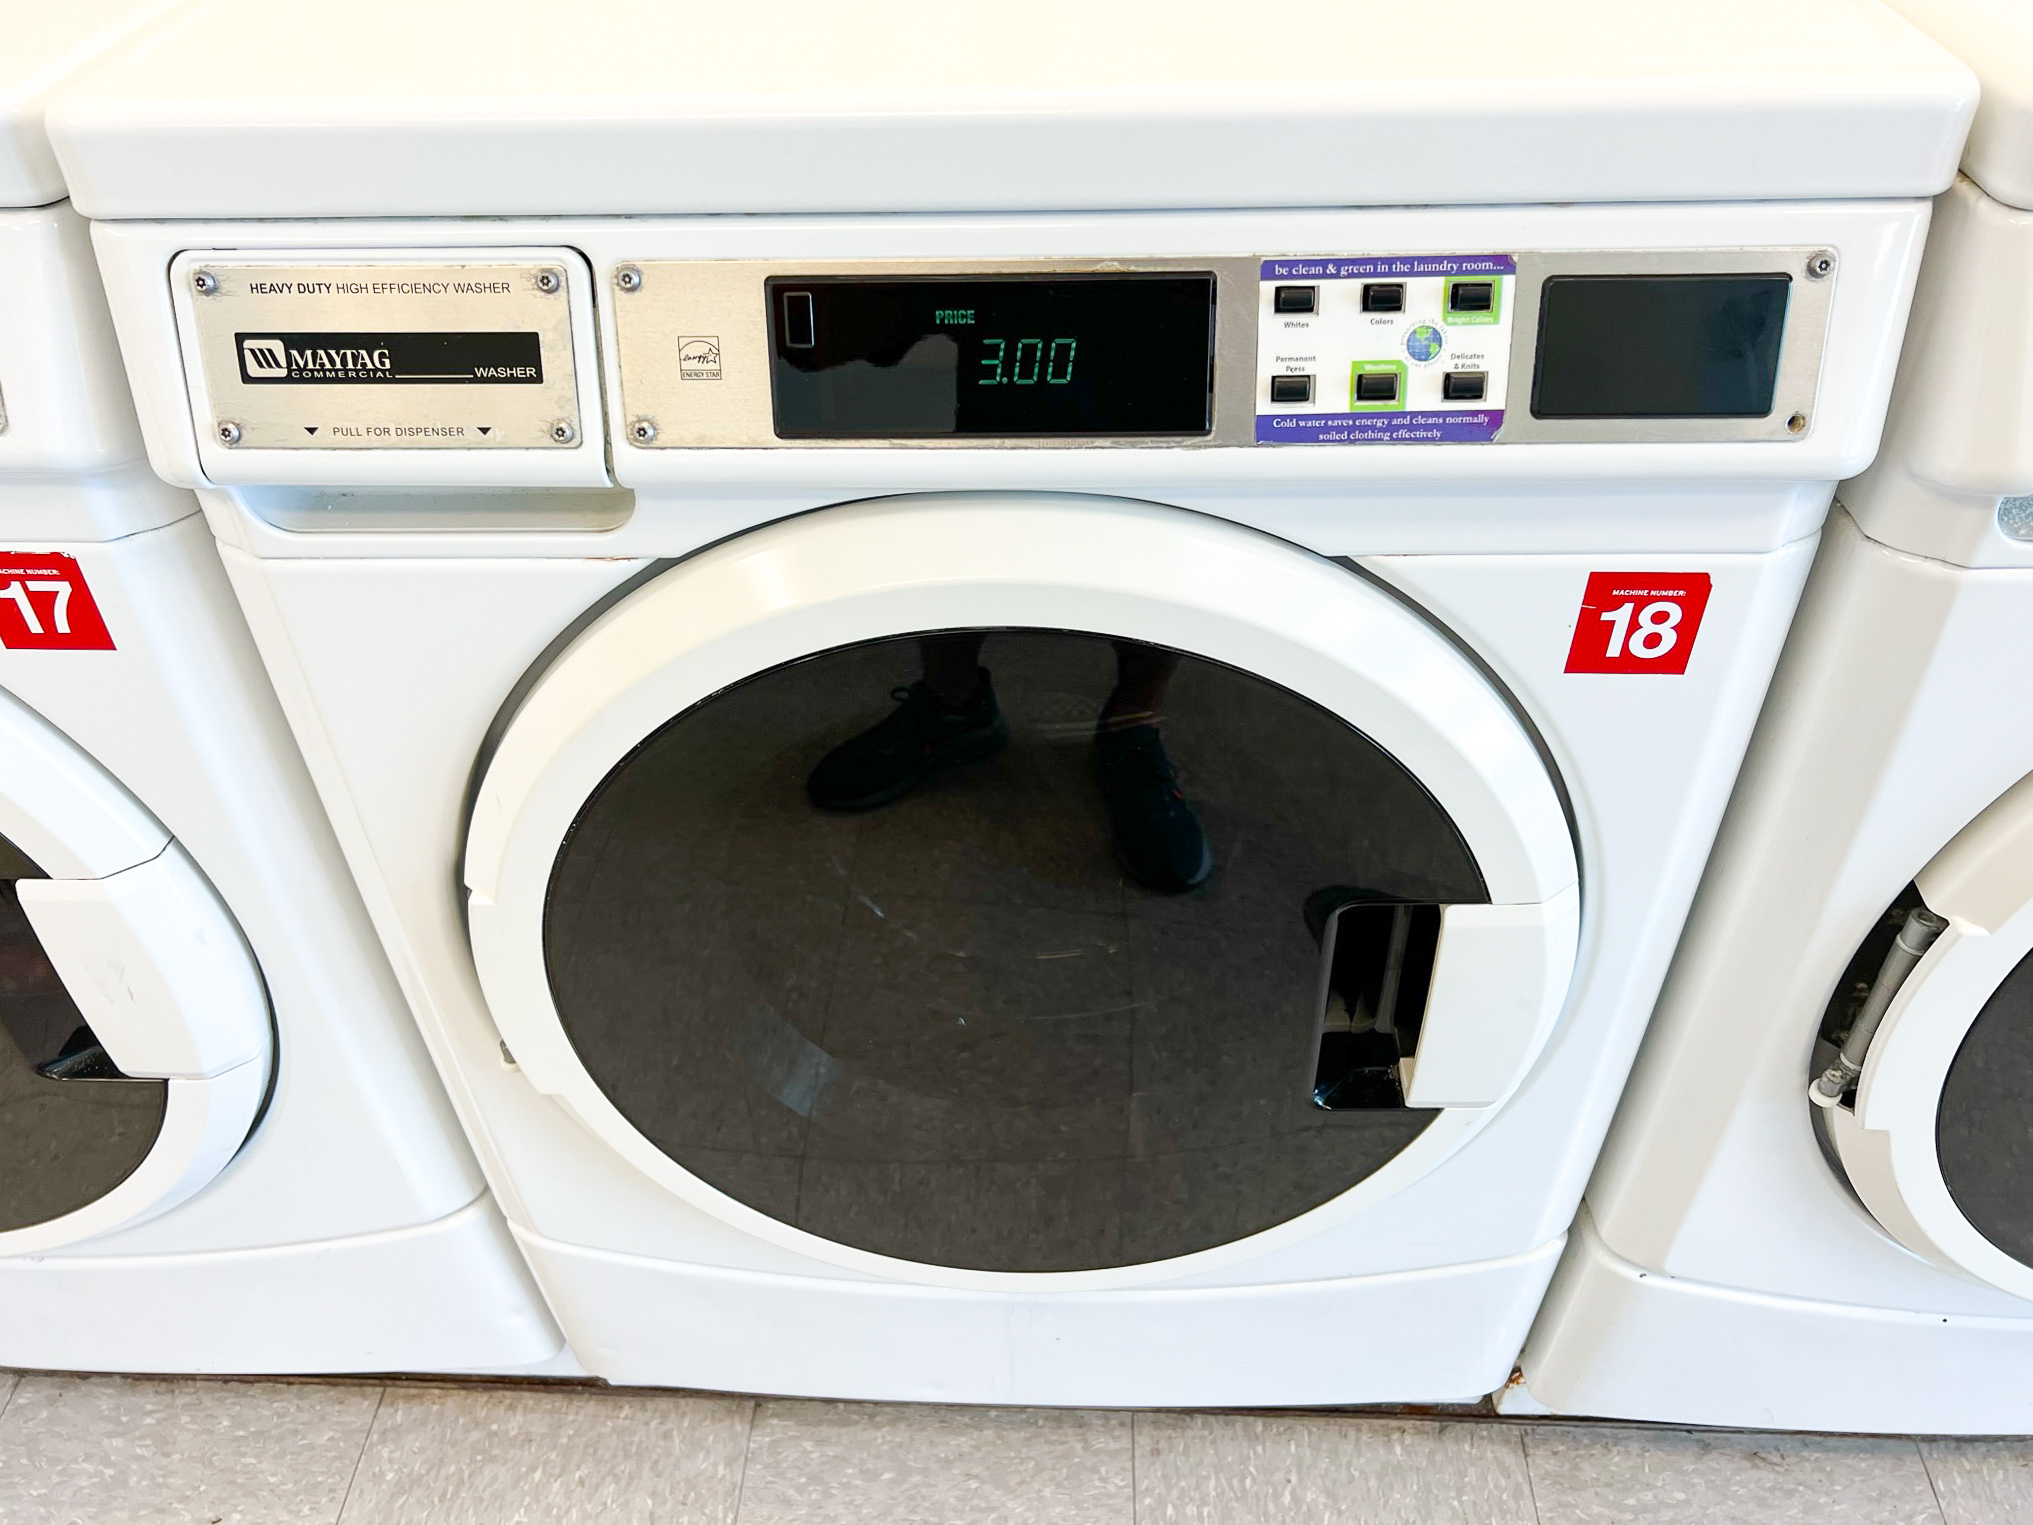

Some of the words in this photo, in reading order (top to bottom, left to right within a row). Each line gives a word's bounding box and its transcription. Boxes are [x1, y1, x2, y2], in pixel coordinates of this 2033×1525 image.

[1275, 264, 1289, 276] be
[1292, 263, 1323, 275] clean
[1326, 263, 1338, 275] &
[1340, 264, 1374, 277] green
[1377, 261, 1389, 273] in
[1392, 261, 1411, 273] the
[1413, 260, 1460, 275] laundry
[1462, 260, 1505, 271] room...
[250, 282, 293, 295] HEAVY
[297, 282, 332, 295] DUTY
[336, 282, 369, 295] HIGH
[372, 282, 450, 295] EFFICIENCY
[453, 282, 511, 295] WASHER
[935, 310, 975, 324] PRICE
[1370, 317, 1394, 326] Colors
[1284, 320, 1309, 329] Whites
[290, 349, 391, 370] MAYTAG
[978, 337, 1077, 385] 3.00
[1276, 355, 1316, 363] Permanent
[1450, 353, 1485, 361] Delicates
[291, 371, 394, 379] COMMERCIAL
[474, 367, 537, 378] WASHER
[1285, 365, 1306, 373] Press
[1273, 418, 1296, 429] Cold
[1298, 418, 1326, 428] water
[1327, 418, 1353, 427] saves
[1355, 417, 1389, 428] energy
[1391, 416, 1411, 426] and
[1413, 415, 1444, 425] cleans
[1446, 415, 1490, 426] normally
[333, 426, 363, 437] PULL
[366, 426, 391, 437] FOR
[394, 426, 465, 437] DISPENSER
[1318, 430, 1348, 441] soiled
[1350, 429, 1391, 441] clothing
[1392, 428, 1442, 441] effectively
[0, 581, 72, 634] 17
[1600, 601, 1683, 659] 18
